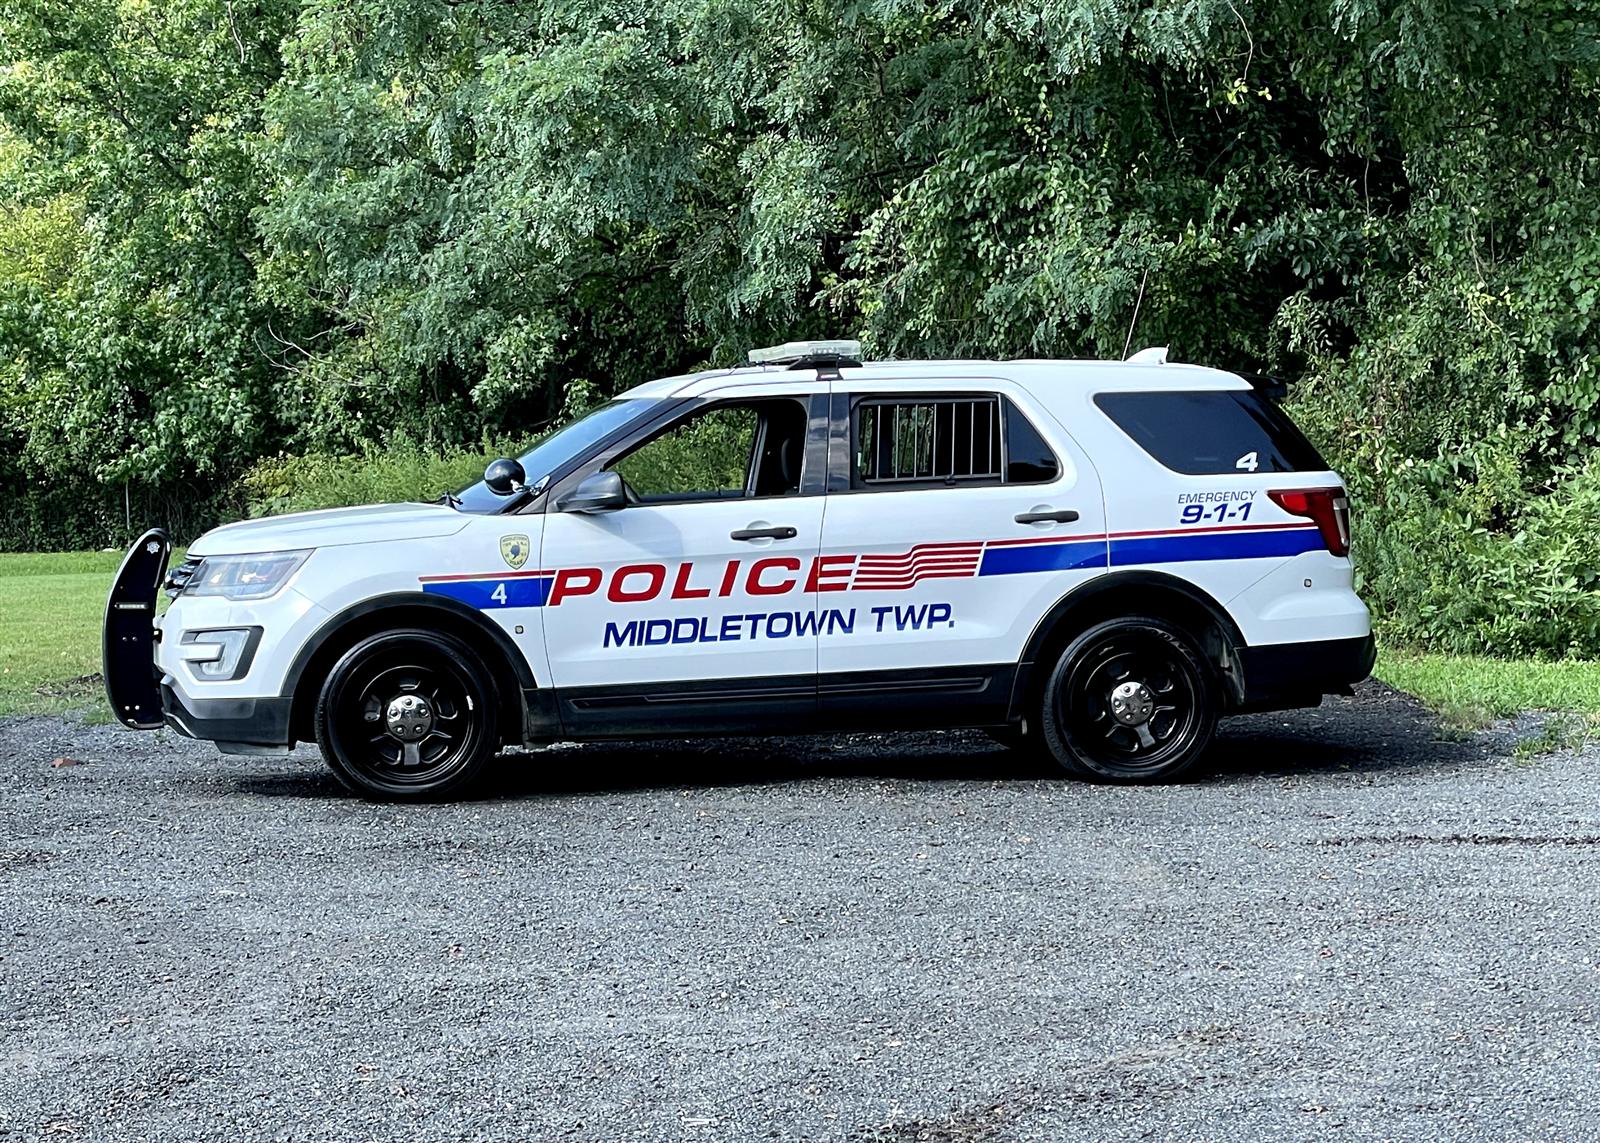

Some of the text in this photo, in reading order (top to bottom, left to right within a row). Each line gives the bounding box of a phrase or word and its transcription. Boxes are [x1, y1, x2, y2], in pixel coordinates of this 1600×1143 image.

[1236, 451, 1258, 472] 4
[1178, 490, 1257, 504] EMERGENCY
[1180, 502, 1252, 524] 9-1-1
[548, 555, 857, 606] POLICE
[491, 583, 507, 605] 4
[603, 603, 955, 648] MIDDLETOWN TWP.
